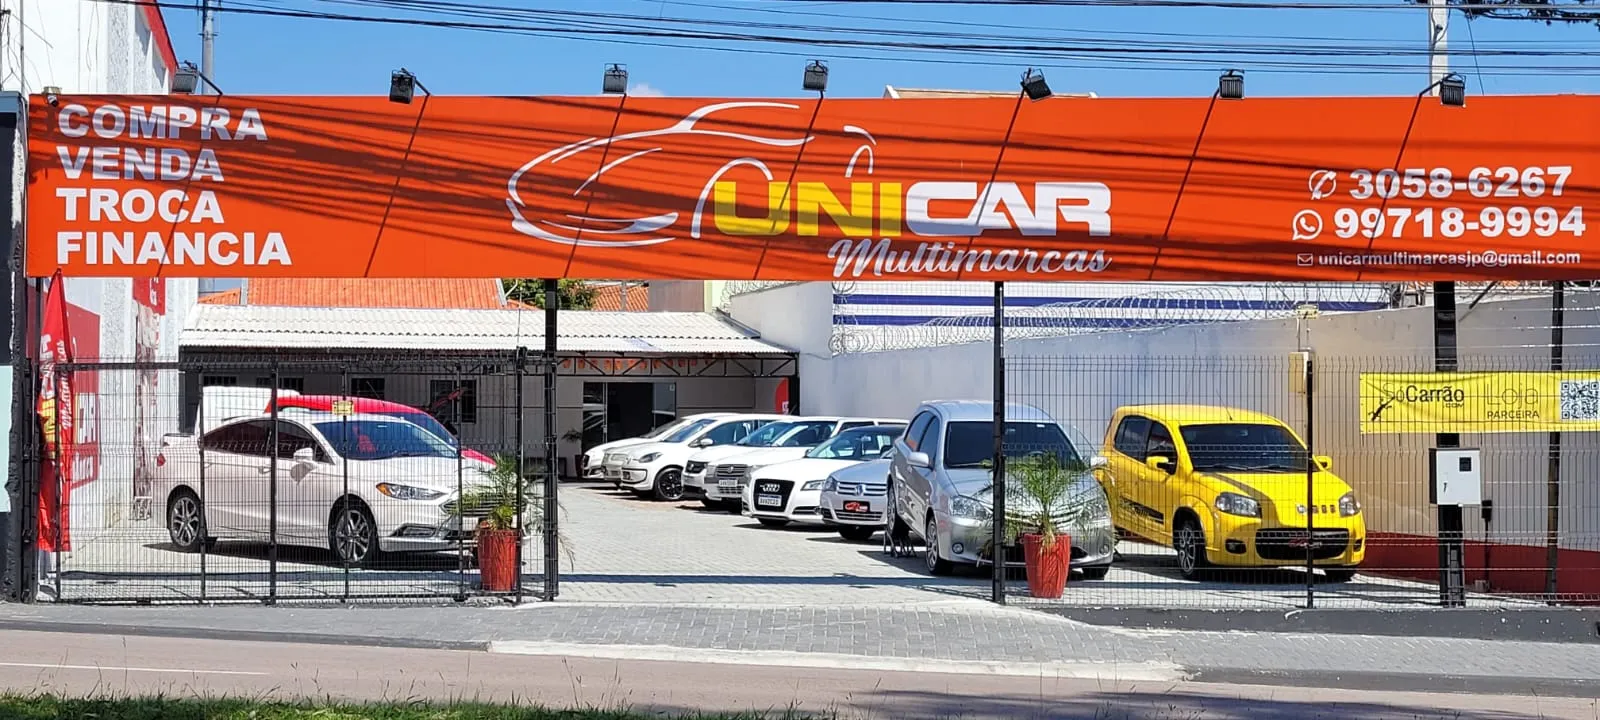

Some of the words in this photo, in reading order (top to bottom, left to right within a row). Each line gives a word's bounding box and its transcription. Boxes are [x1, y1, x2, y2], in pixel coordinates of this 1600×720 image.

[58, 105, 267, 140] COMPRA
[57, 146, 224, 181] VENDA
[1350, 166, 1572, 199] 3058-6267
[56, 188, 224, 223] TROCA
[714, 181, 1111, 236] UNICAR
[1333, 207, 1586, 238] 99718-9994
[57, 232, 292, 265] FINANCIA
[829, 238, 1112, 277] Multimarcas
[1318, 251, 1580, 266] unicarmultimarcasjp@gmail.com
[1487, 382, 1538, 408] Loja
[1486, 411, 1539, 420] PARCEIRA
